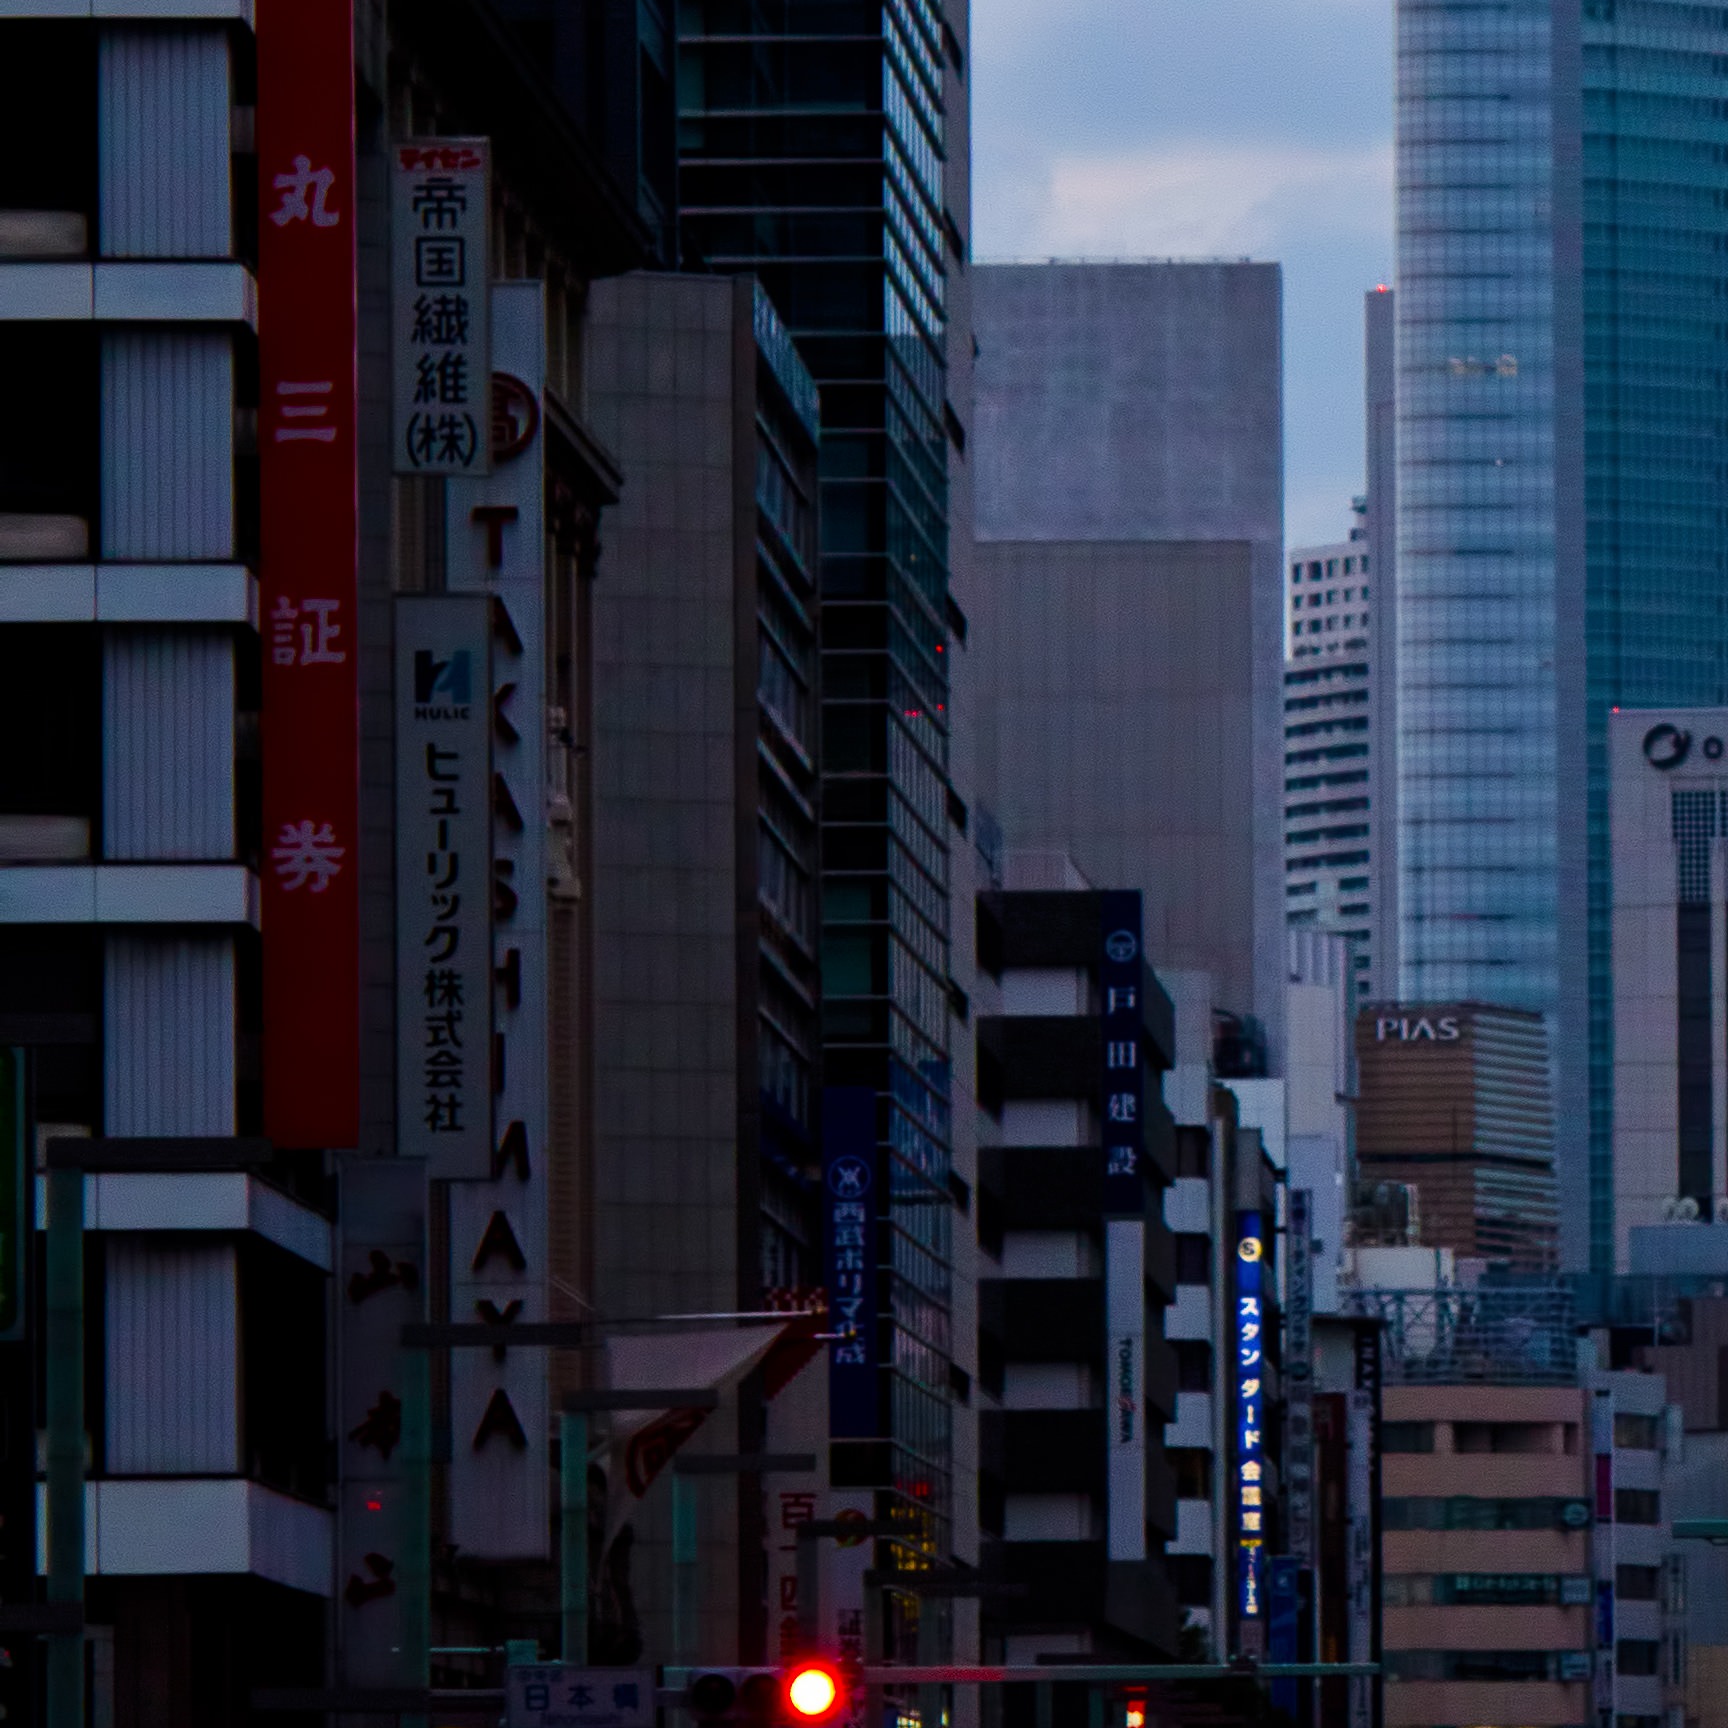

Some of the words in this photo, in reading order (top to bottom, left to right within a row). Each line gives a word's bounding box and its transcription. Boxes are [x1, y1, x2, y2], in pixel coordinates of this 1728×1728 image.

[270, 155, 346, 892] 丸三証券
[415, 707, 470, 719] HULIC
[425, 743, 464, 1132] ヒューリック株式会社
[1377, 1017, 1460, 1041] PIAS
[526, 1683, 639, 1710] 日本橋
